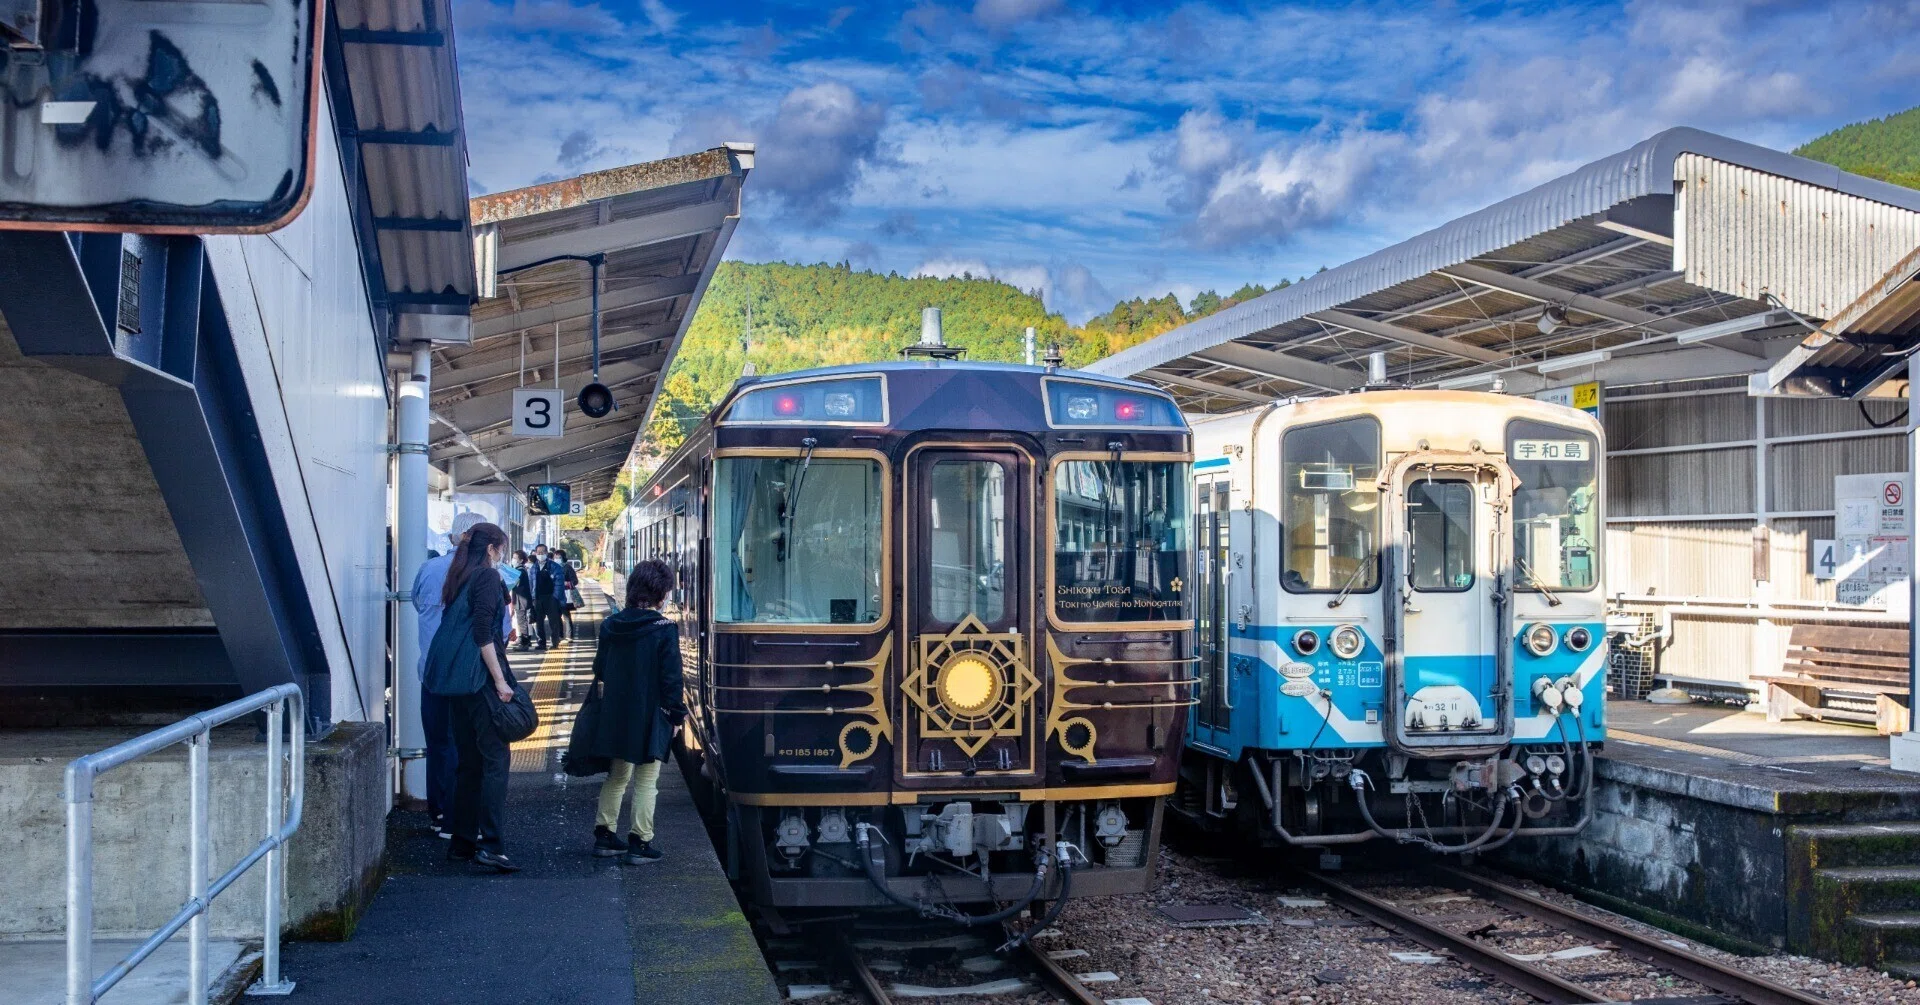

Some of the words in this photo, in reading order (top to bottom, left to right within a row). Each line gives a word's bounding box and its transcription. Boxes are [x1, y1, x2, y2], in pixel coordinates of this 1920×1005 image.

[524, 397, 551, 429] 3
[1519, 443, 1581, 458] 宇和島
[571, 503, 580, 514] 3
[1820, 546, 1836, 574] 4
[1104, 585, 1131, 594] TOSA
[1060, 600, 1079, 609] TOKI
[1092, 600, 1120, 609] YOAKE
[1134, 599, 1183, 609] MONOGATARI
